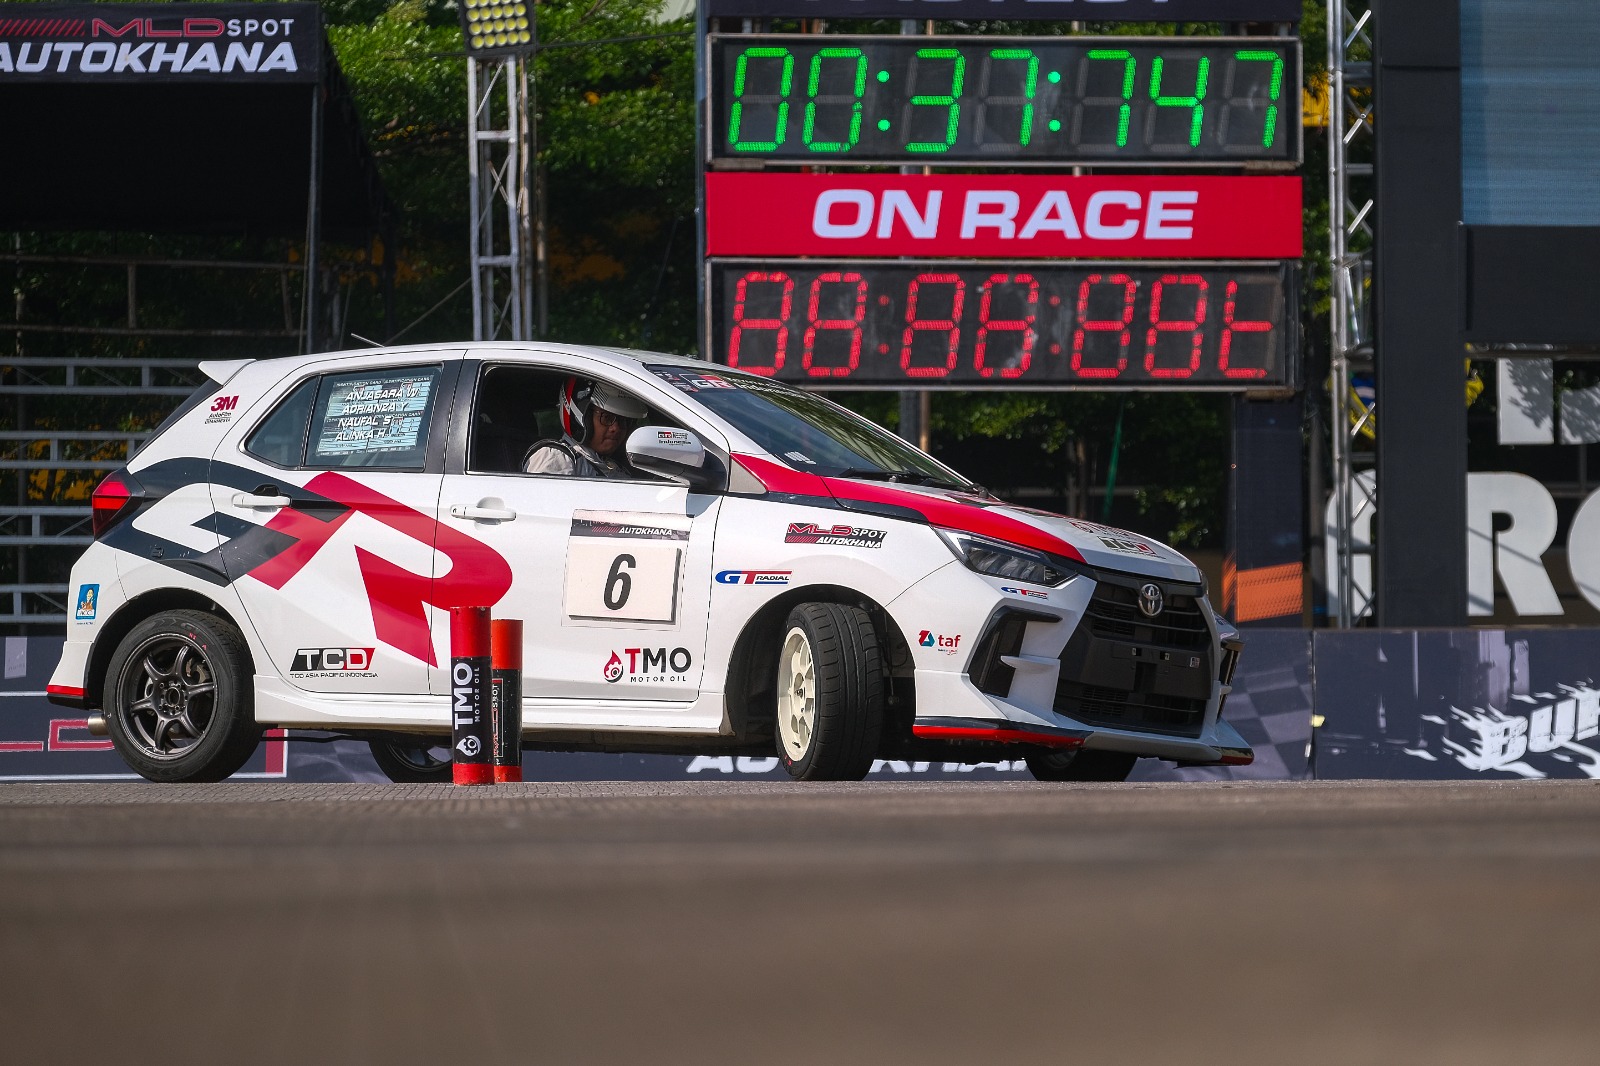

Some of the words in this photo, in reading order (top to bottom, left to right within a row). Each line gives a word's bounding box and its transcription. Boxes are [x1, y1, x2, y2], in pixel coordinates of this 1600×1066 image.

[811, 189, 943, 239] ON
[960, 190, 1200, 240] RACE
[345, 388, 404, 401] ANJASARA
[211, 395, 239, 411] 3M
[341, 402, 396, 415] ADRIANZA
[338, 416, 378, 427] NAUFAL
[334, 430, 373, 441] ALINKA
[619, 526, 673, 536] AUTOKHANA
[816, 536, 882, 549] AUTOKHANA
[603, 553, 637, 611] 6
[938, 635, 961, 647] taf
[298, 648, 368, 670] TCD
[624, 647, 692, 674] TMO
[453, 662, 474, 731] TMO
